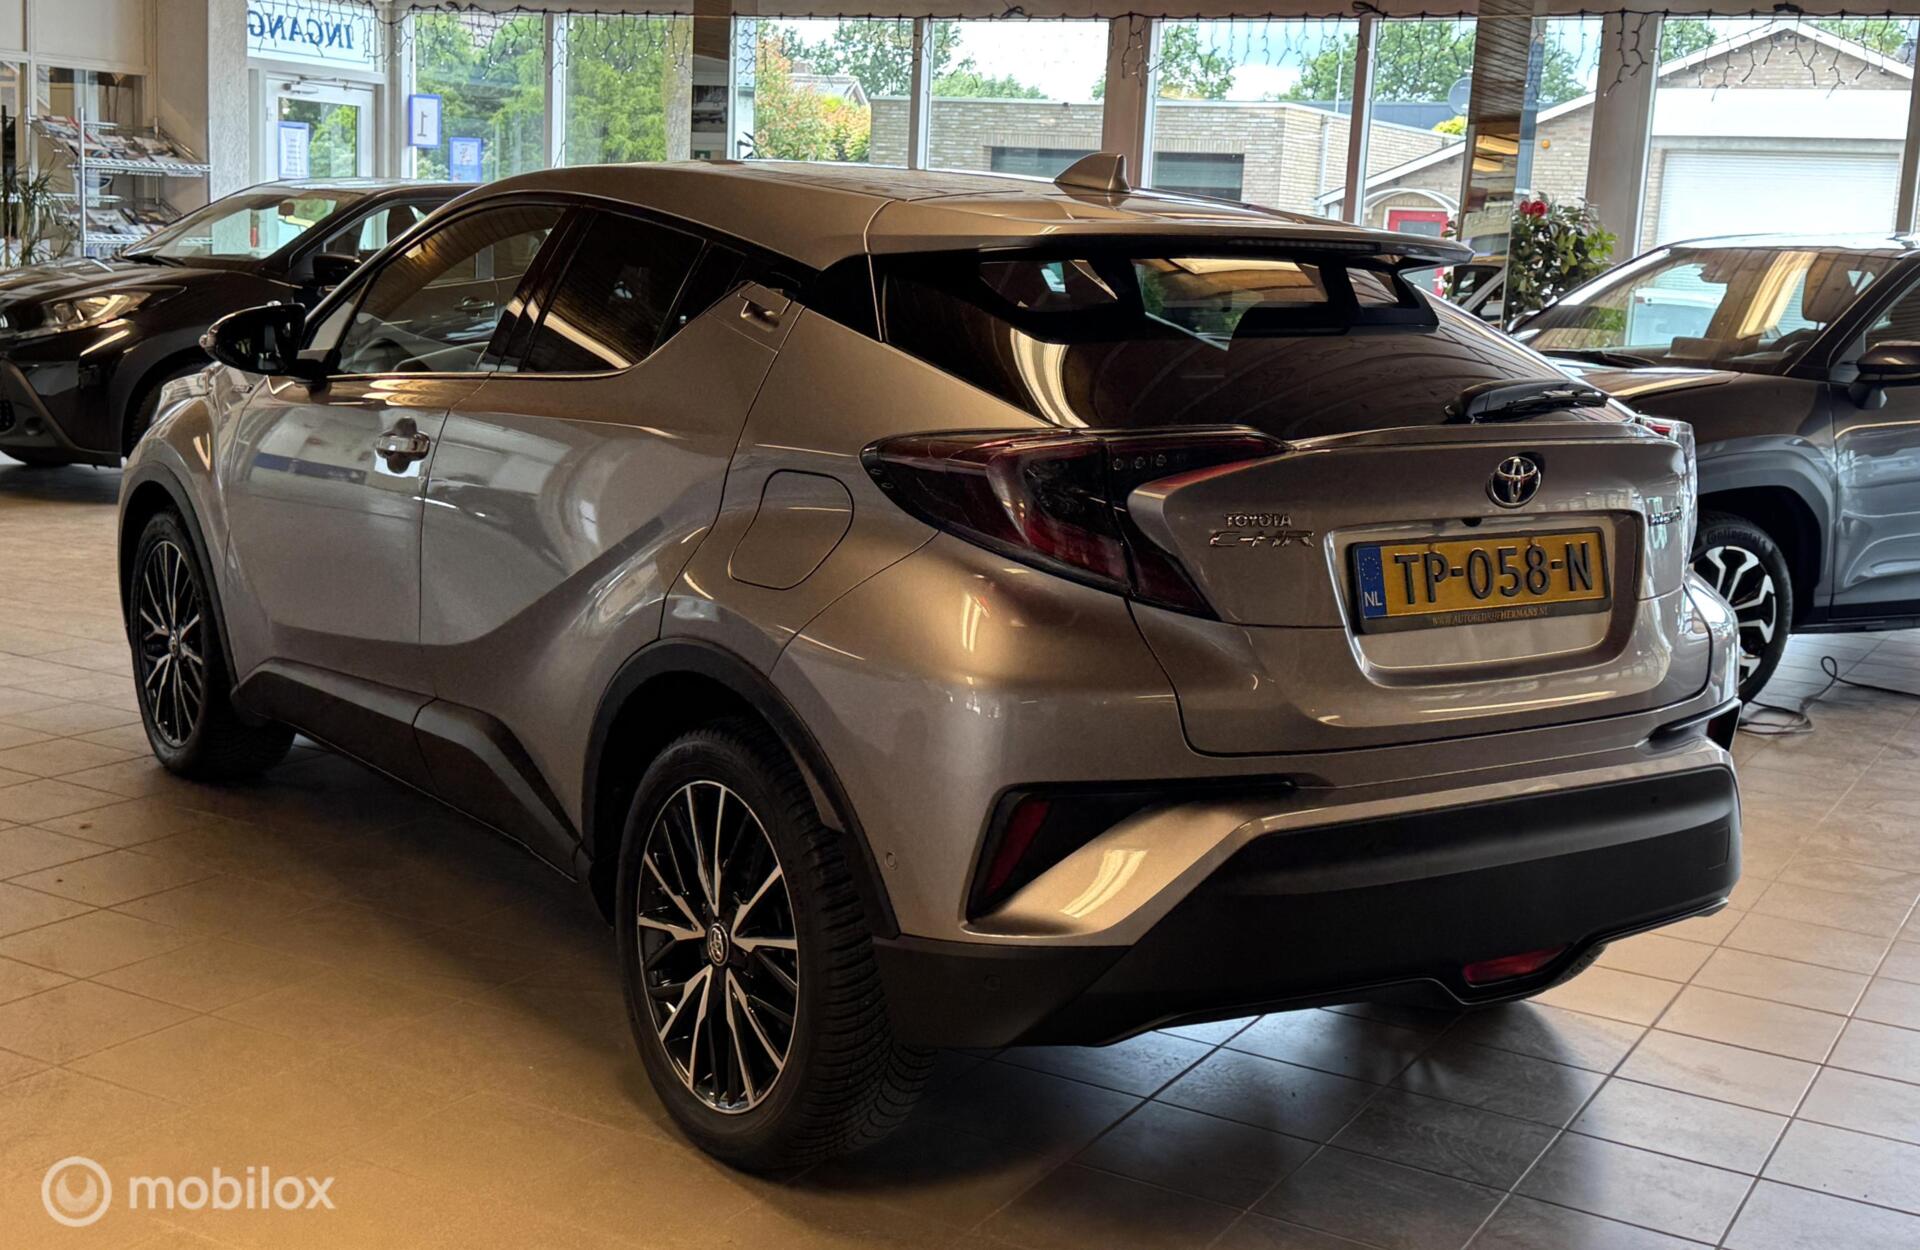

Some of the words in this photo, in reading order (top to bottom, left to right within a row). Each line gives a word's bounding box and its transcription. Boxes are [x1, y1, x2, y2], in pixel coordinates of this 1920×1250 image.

[1224, 513, 1293, 528] TOYOTA
[1394, 541, 1593, 605] TP-058-N
[1363, 591, 1383, 608] NL
